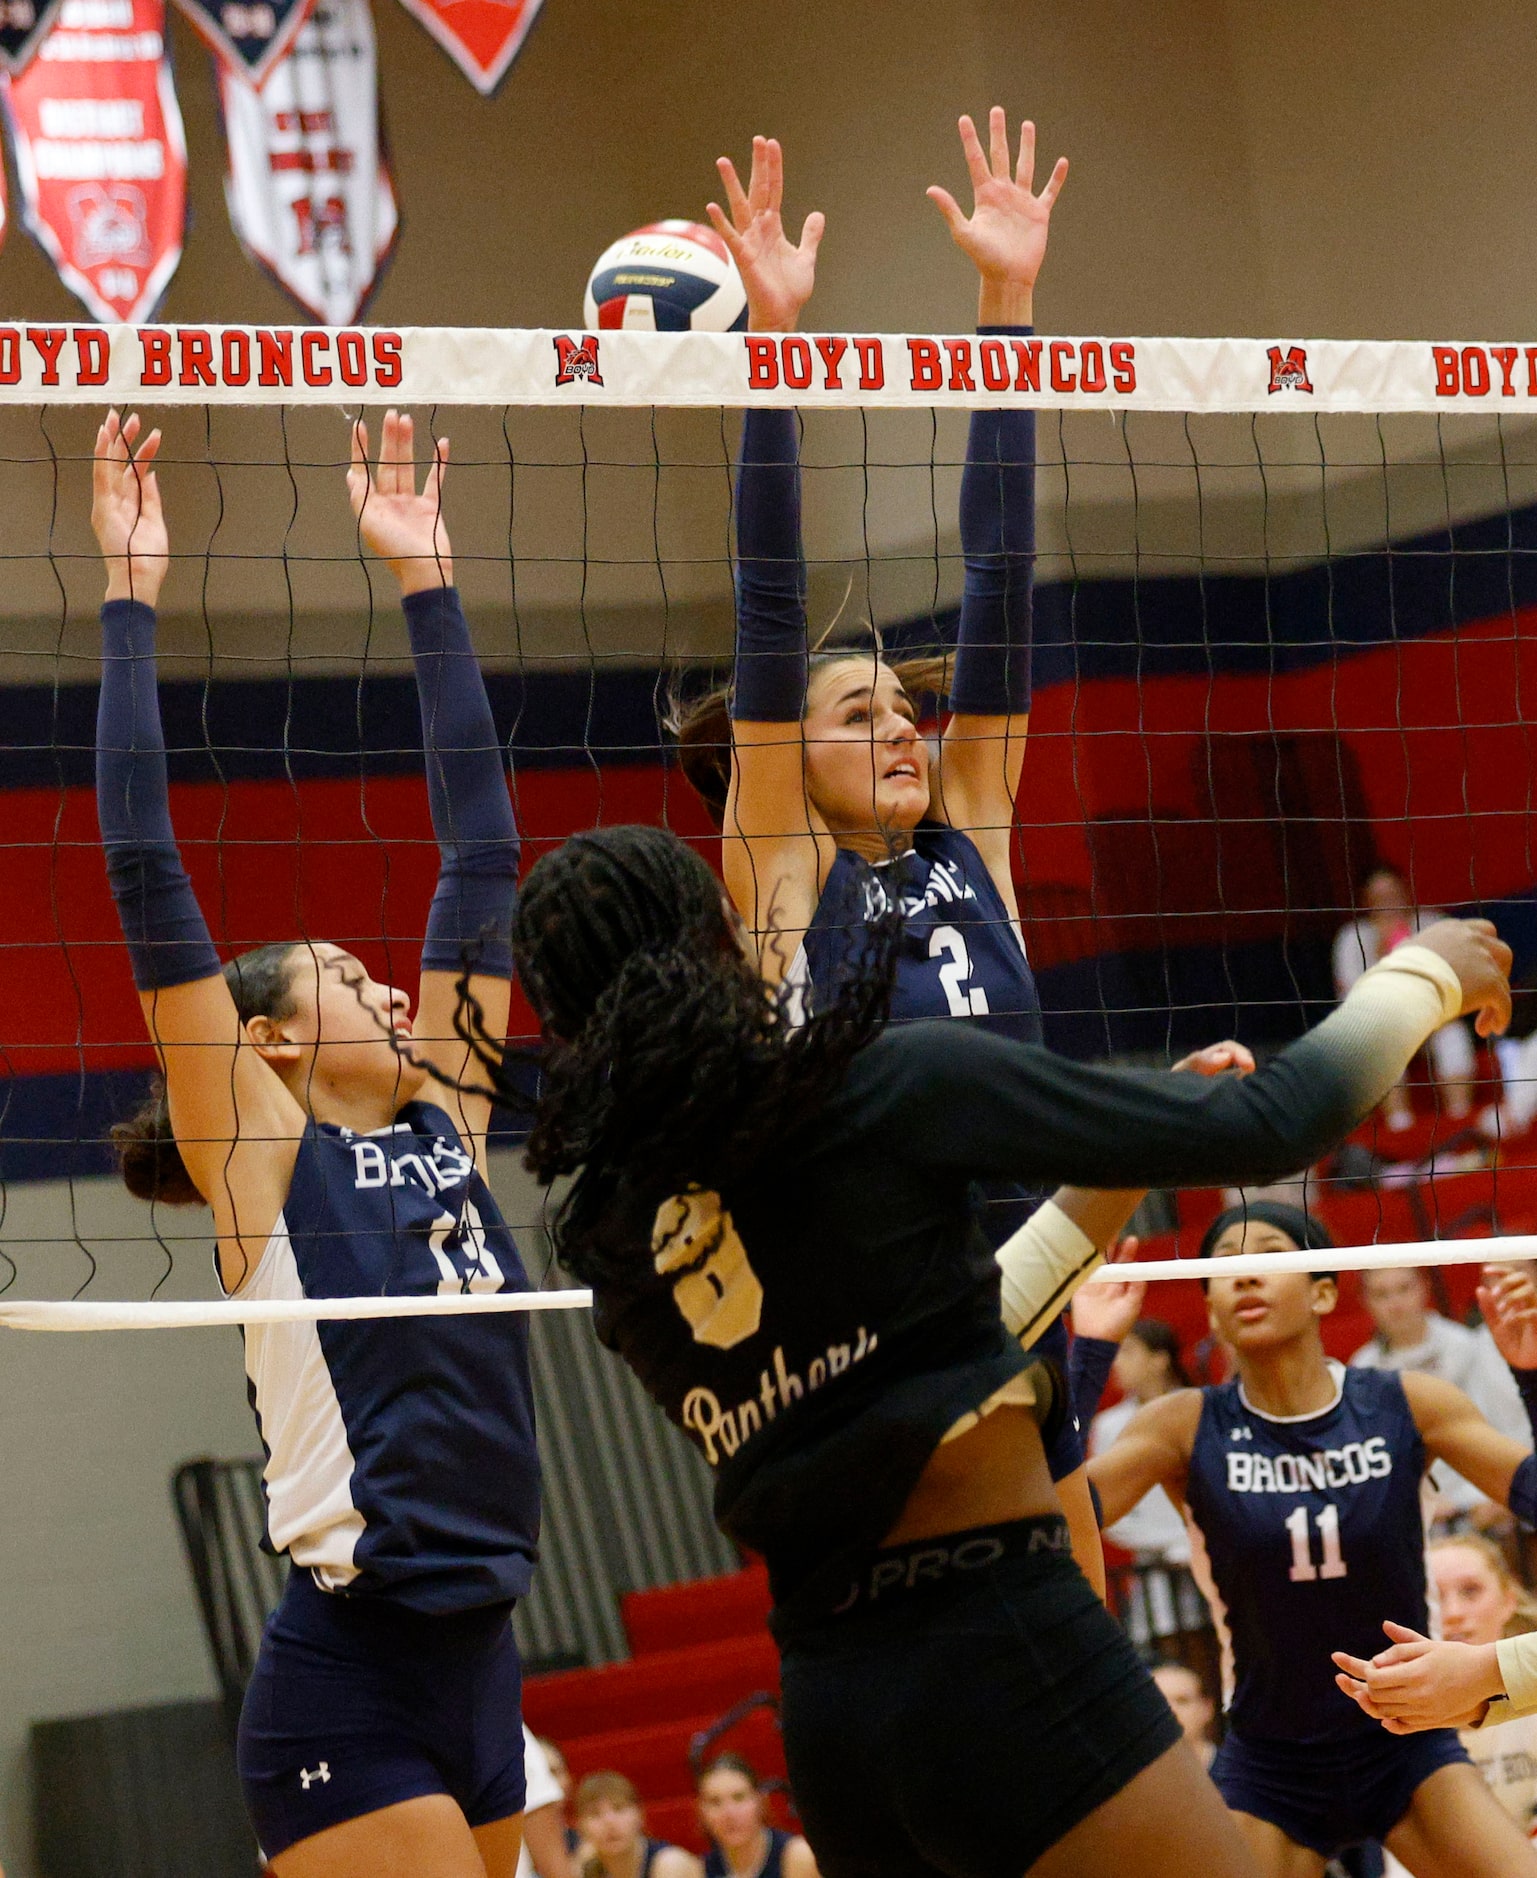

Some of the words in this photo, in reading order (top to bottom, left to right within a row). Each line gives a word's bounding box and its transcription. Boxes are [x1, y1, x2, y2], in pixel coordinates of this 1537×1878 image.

[138, 329, 403, 388] BRONCOS
[565, 362, 595, 375] BOYD
[744, 336, 886, 391] BOYD
[906, 338, 1137, 394] BRONCOS
[1274, 372, 1304, 385] BOYD
[928, 925, 990, 1018] 2
[428, 1198, 506, 1296] 13
[1226, 1436, 1394, 1494] BRONCOS
[869, 1537, 1004, 1600] PRO
[1284, 1503, 1348, 1583] 11
